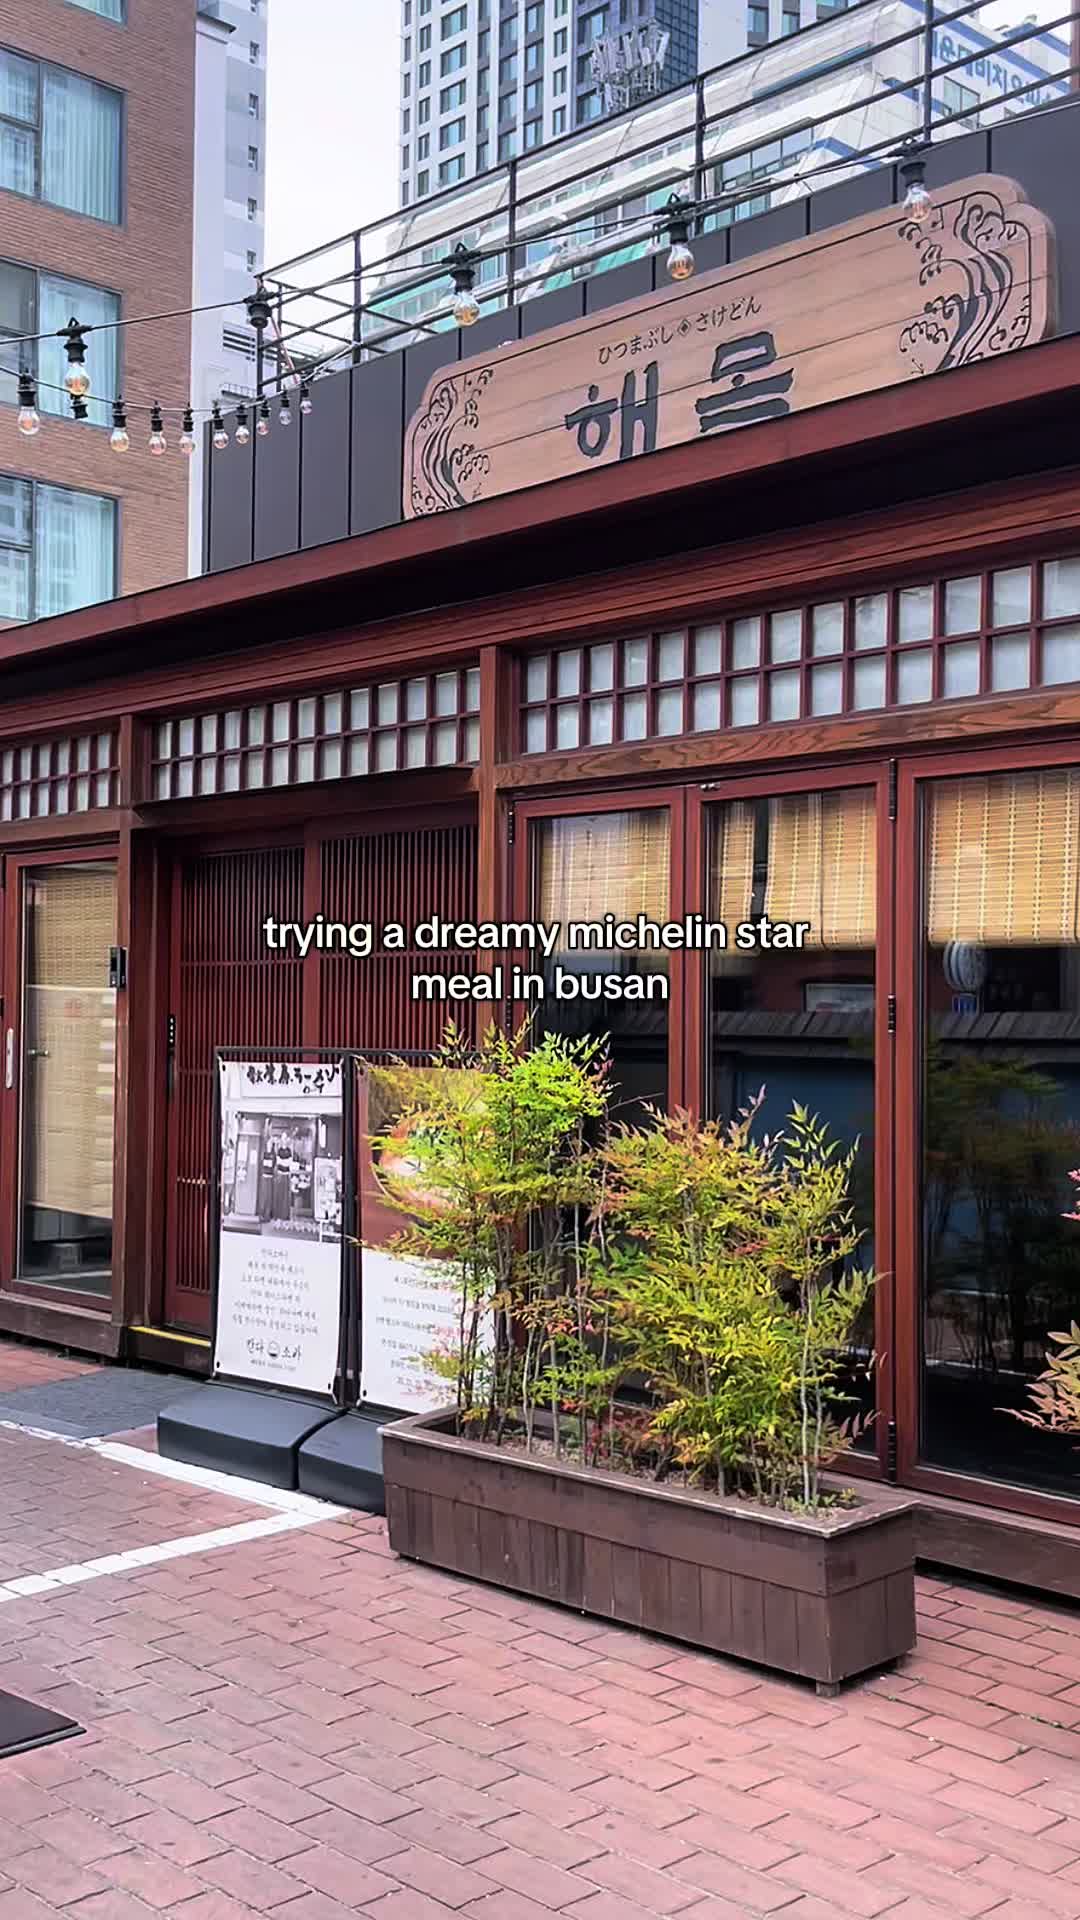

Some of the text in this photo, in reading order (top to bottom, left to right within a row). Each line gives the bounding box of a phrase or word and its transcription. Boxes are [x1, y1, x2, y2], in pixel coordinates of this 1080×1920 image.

[598, 296, 762, 365] ひつまぶし さけどん
